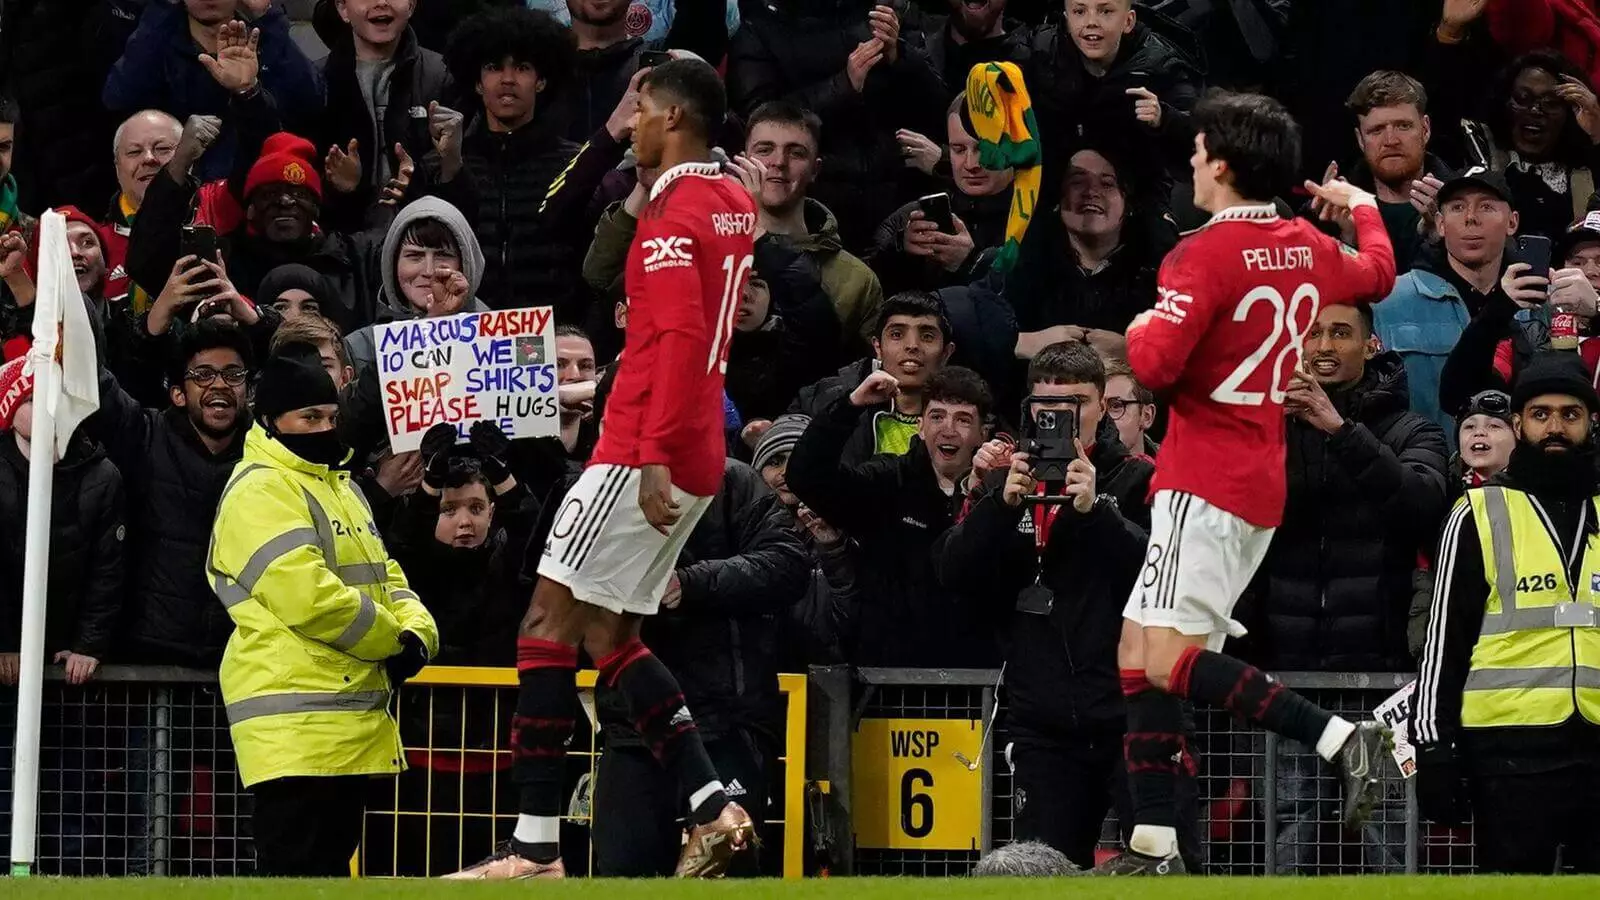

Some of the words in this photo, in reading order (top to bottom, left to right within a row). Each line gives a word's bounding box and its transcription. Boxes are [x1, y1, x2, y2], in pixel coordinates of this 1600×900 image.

[380, 314, 479, 352] MARCUS
[479, 309, 552, 337] RASHY
[1209, 282, 1320, 405] 28
[411, 346, 452, 369] CAN
[471, 339, 513, 367] WE
[385, 372, 452, 405] SWAP
[466, 364, 555, 393] SHIRTS
[390, 394, 482, 435] PLEASE
[1516, 573, 1557, 593] 426
[890, 730, 940, 758] WSP
[901, 767, 934, 838] 6
